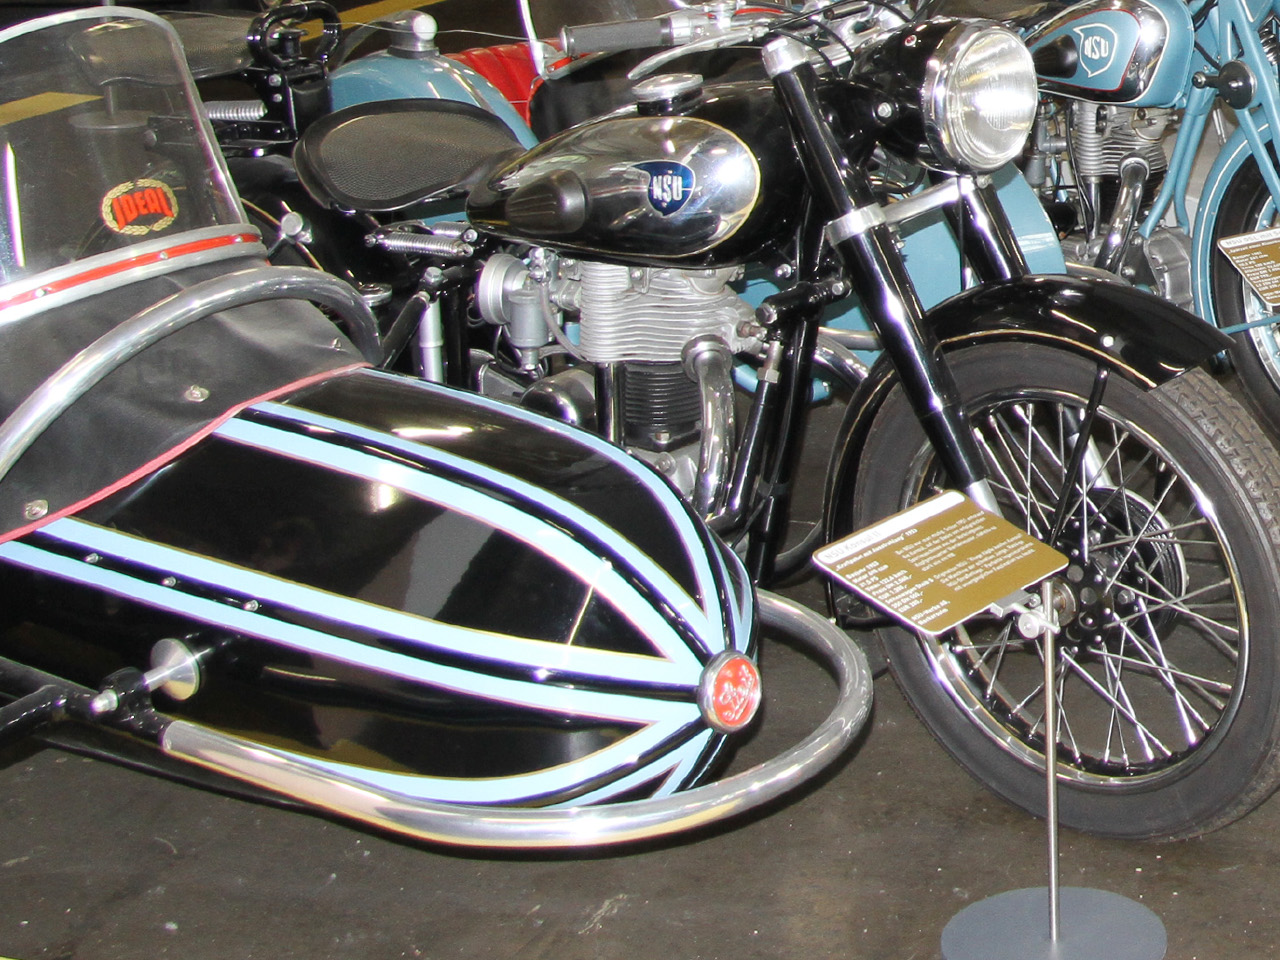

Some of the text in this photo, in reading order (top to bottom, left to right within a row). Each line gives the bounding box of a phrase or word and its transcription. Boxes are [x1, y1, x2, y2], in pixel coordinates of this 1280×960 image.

[1084, 35, 1109, 60] NSU
[652, 174, 683, 203] NSU
[111, 186, 175, 231] IDEAL
[1225, 238, 1242, 247] NSU
[1259, 232, 1273, 240] mit
[825, 547, 844, 560] NSU
[845, 534, 872, 551] Konsul
